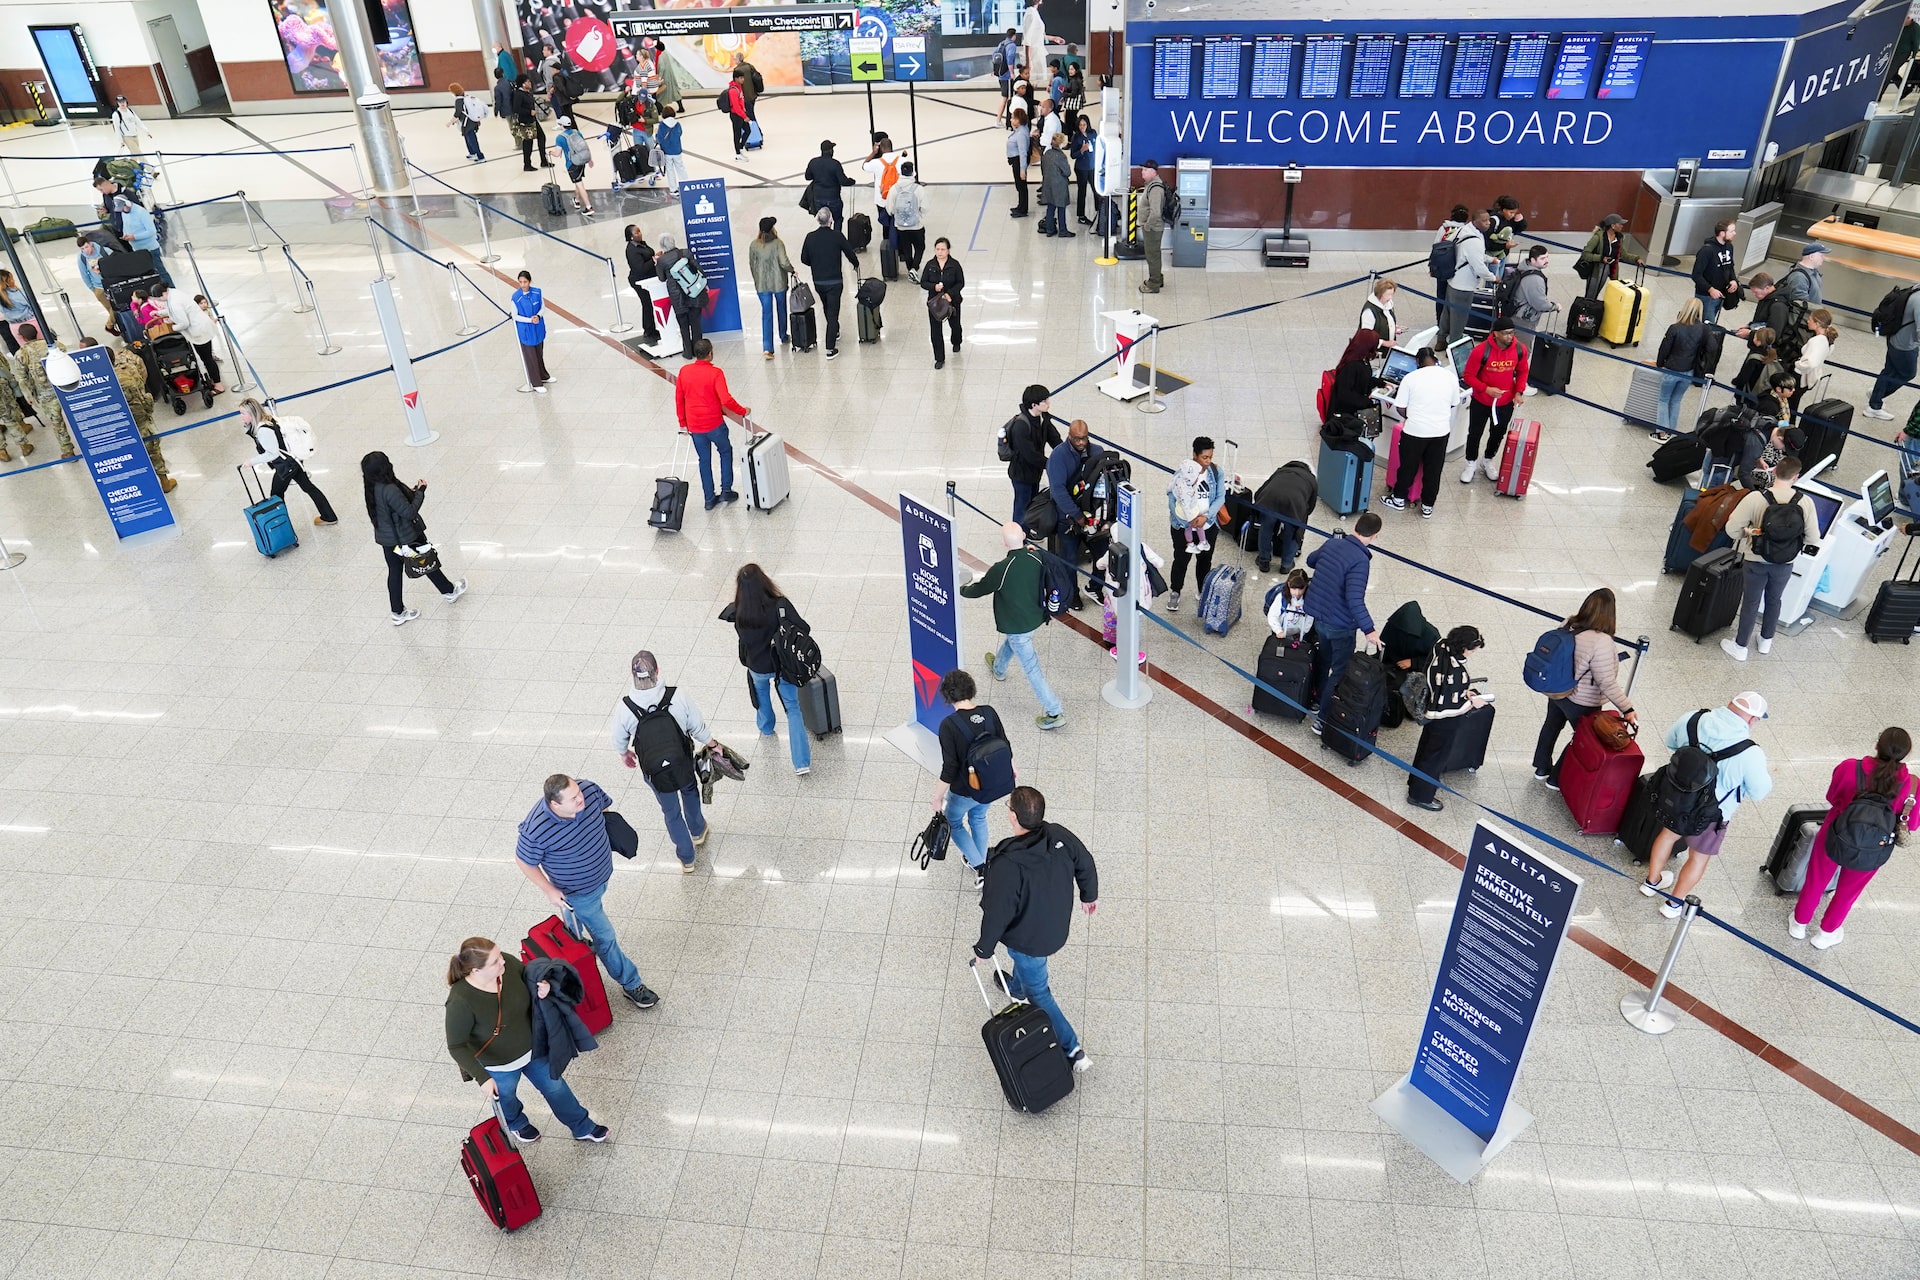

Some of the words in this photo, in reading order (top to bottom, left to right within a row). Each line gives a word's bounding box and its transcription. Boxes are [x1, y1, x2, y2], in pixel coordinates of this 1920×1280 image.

[664, 20, 710, 30] Checkpoint
[749, 18, 773, 26] South
[774, 16, 820, 26] Checkpoint
[1800, 54, 1871, 104] DELTA
[1170, 110, 1400, 144] WELCOME
[1416, 110, 1612, 144] ABOARD
[75, 356, 92, 364] LTA
[94, 454, 133, 468] PASSENGER
[97, 463, 123, 474] NOTICE
[107, 486, 138, 497] CHECKED
[110, 491, 142, 503] BAGGAGE
[913, 508, 940, 528] DELTA
[912, 572, 942, 595] CHECK-IN
[943, 590, 948, 599] &
[920, 568, 939, 585] KIOSK
[915, 582, 928, 595] BAG
[929, 591, 946, 606] DROP
[1500, 850, 1546, 884] DELTA
[1477, 864, 1534, 906] EFFECTIVE
[1475, 874, 1552, 928] IMMEDIATELY
[1442, 997, 1480, 1028] NOTICE
[1444, 988, 1502, 1034] PASSENGER
[1431, 1038, 1479, 1077] BAGGAGE
[1434, 1030, 1478, 1066] CHECKED
